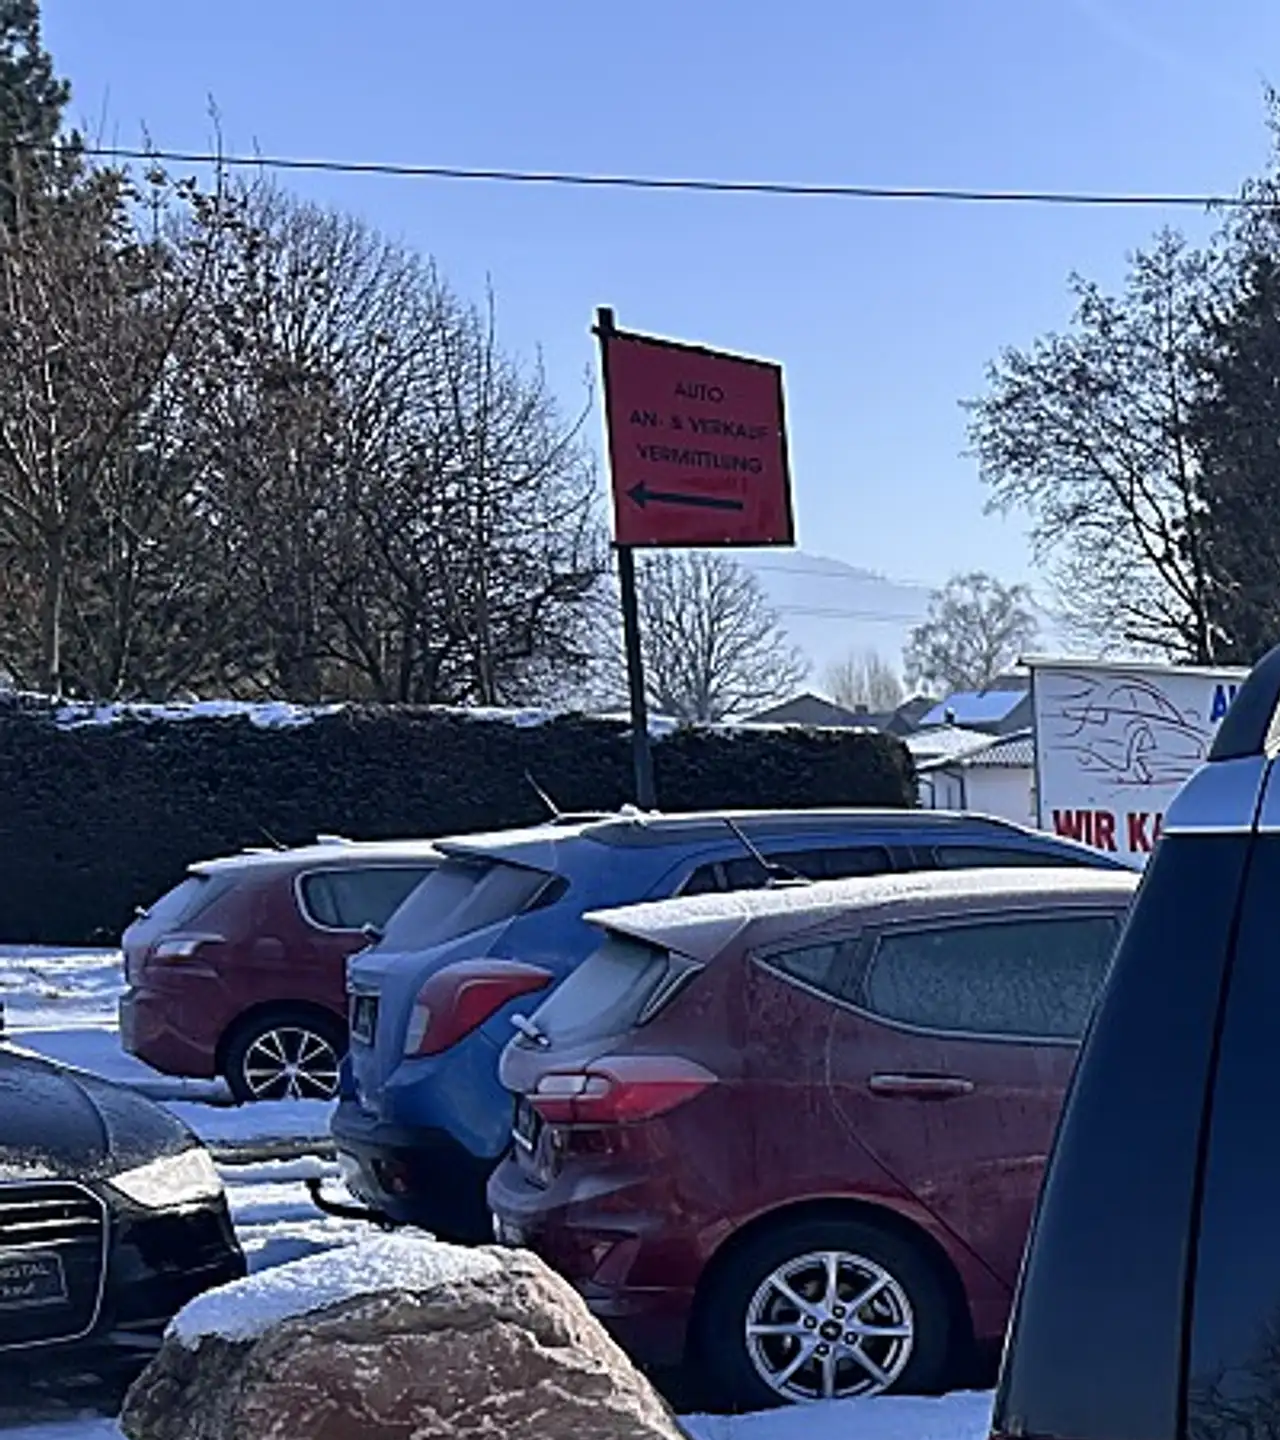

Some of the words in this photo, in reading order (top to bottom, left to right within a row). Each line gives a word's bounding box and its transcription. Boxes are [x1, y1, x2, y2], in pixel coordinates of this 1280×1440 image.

[674, 381, 725, 403] AUTO
[687, 414, 769, 441] VERKAUF
[635, 442, 764, 475] VERMITTLUNG
[1052, 809, 1118, 853] WIR
